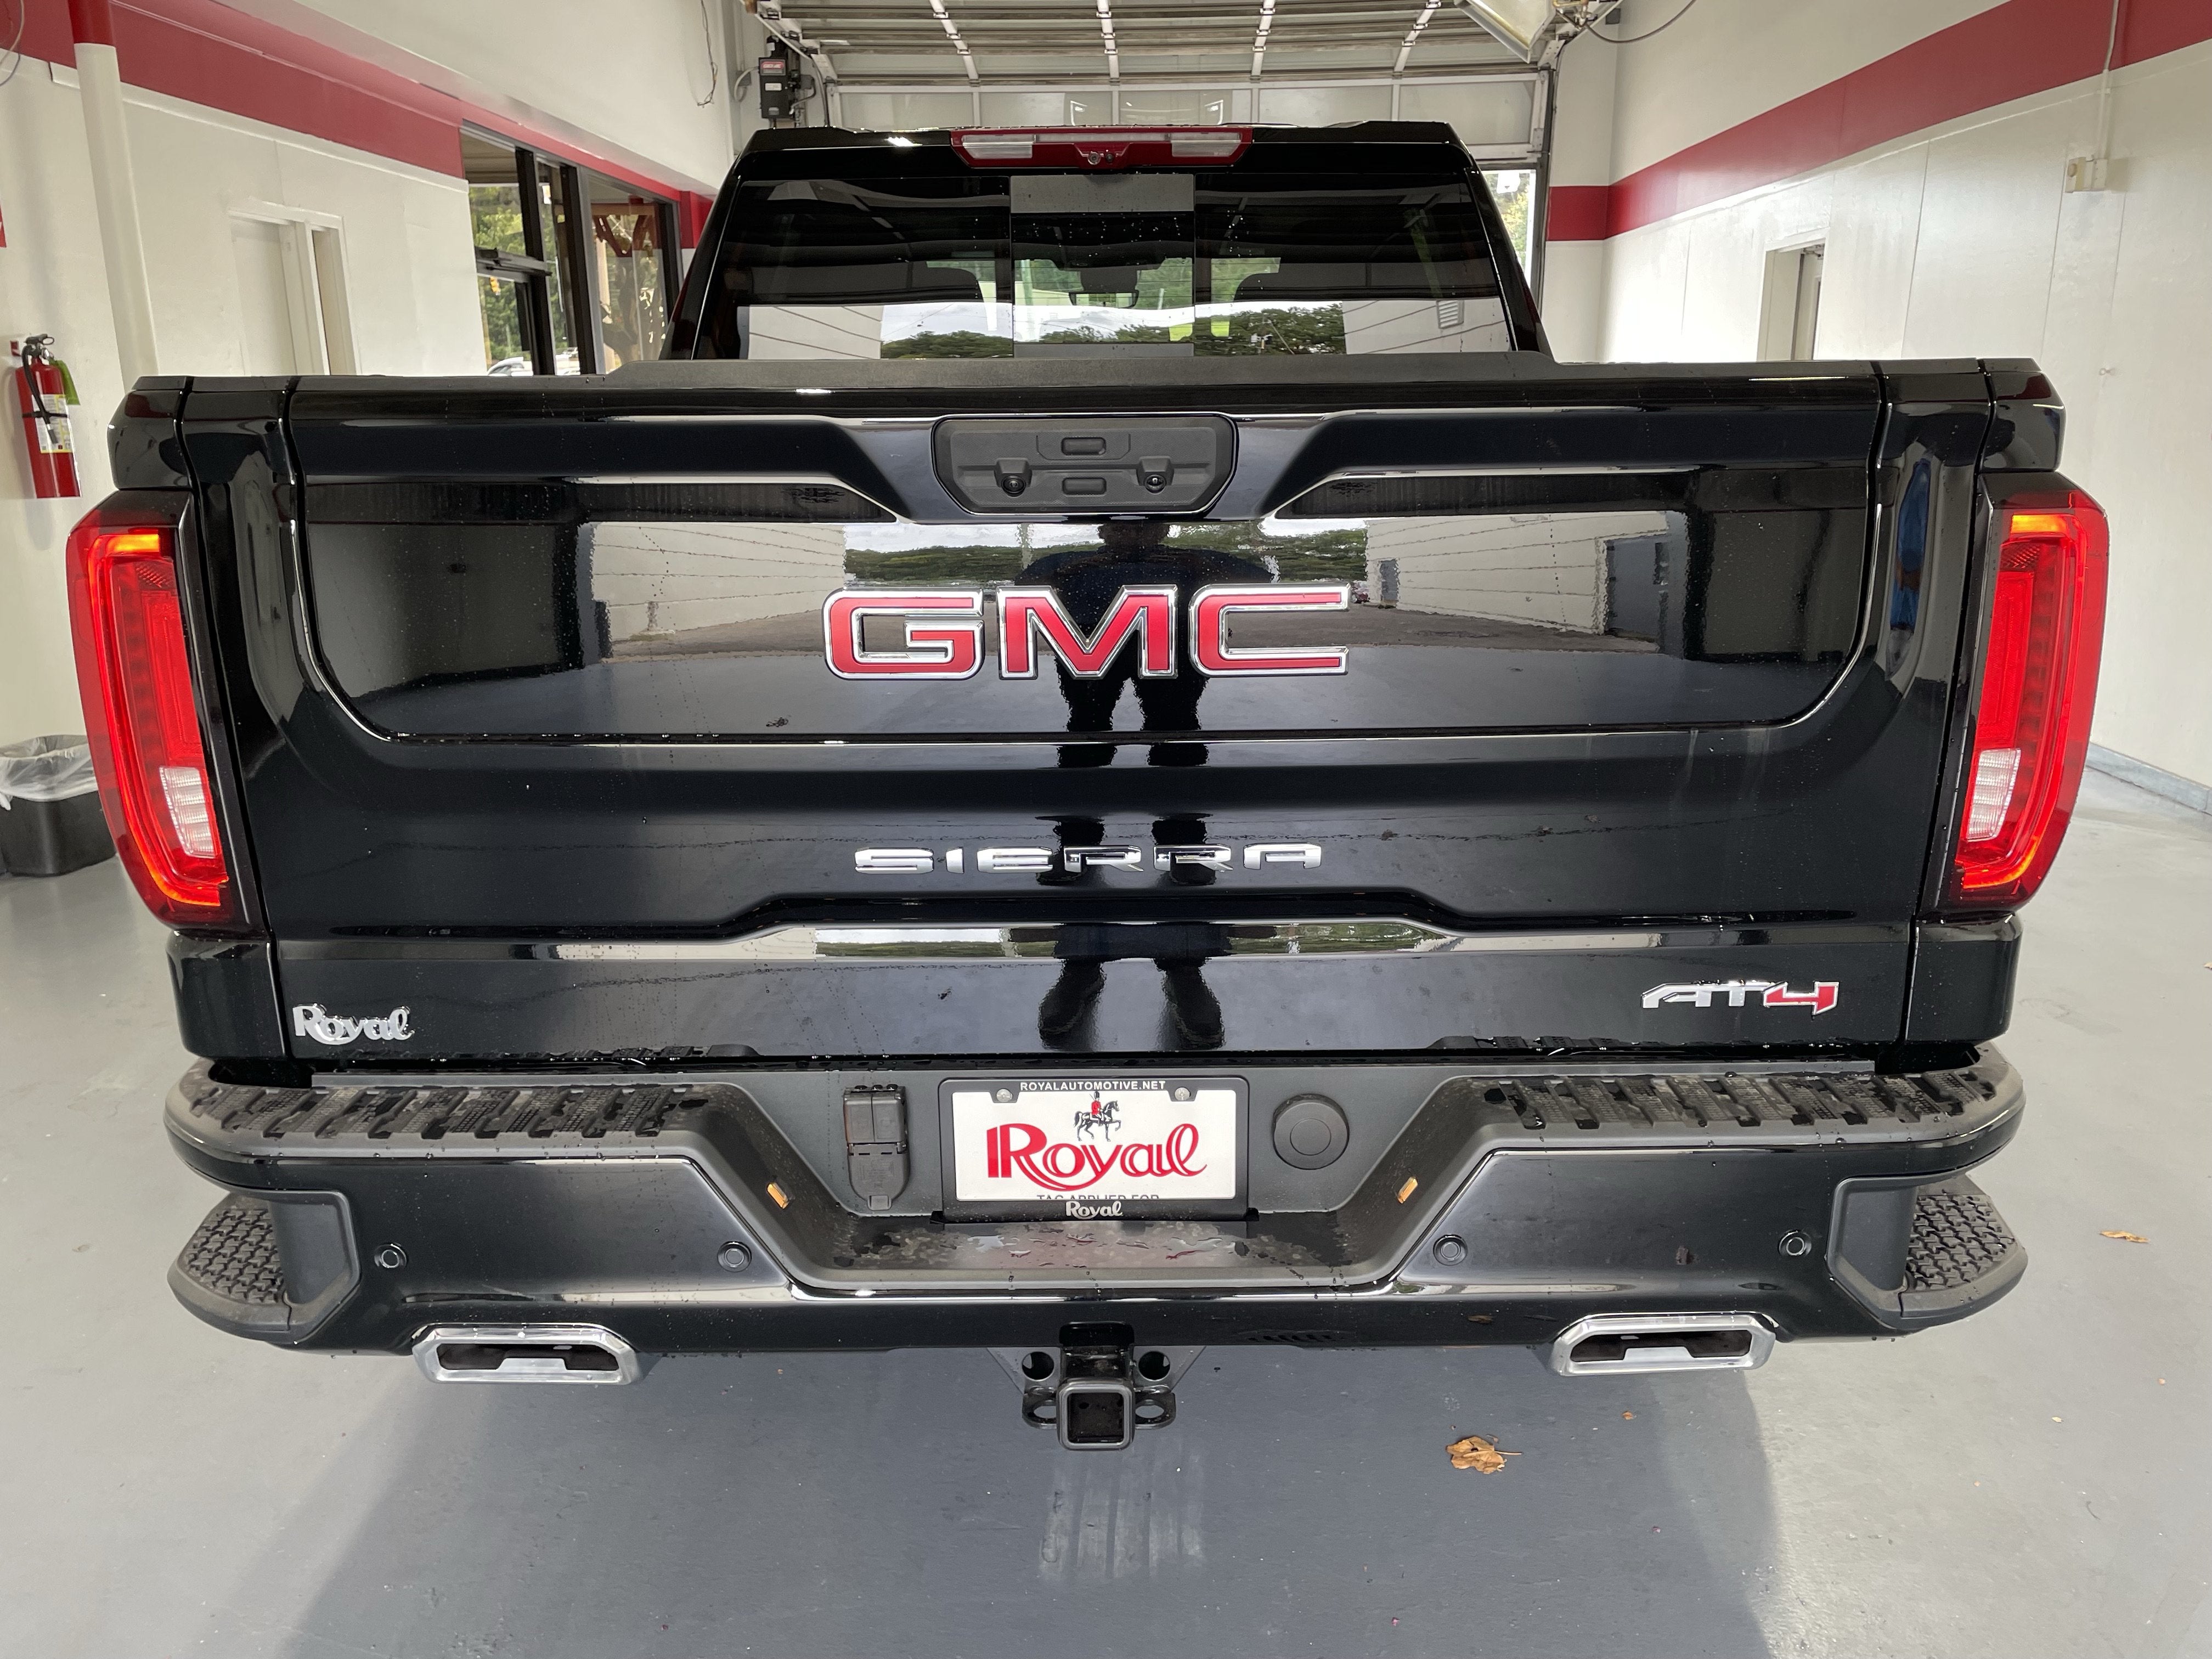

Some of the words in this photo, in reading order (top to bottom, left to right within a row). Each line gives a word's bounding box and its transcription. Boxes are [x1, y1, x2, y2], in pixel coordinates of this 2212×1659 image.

[823, 583, 1352, 680] GMC
[855, 843, 1322, 874] SIERRA
[1641, 980, 1839, 1015] AT4
[292, 1003, 415, 1045] Royal
[1020, 1081, 1166, 1091] ROYALAUTOMOTIVE.NET
[986, 1123, 1207, 1191] Royal
[1066, 1200, 1123, 1220] Royal
